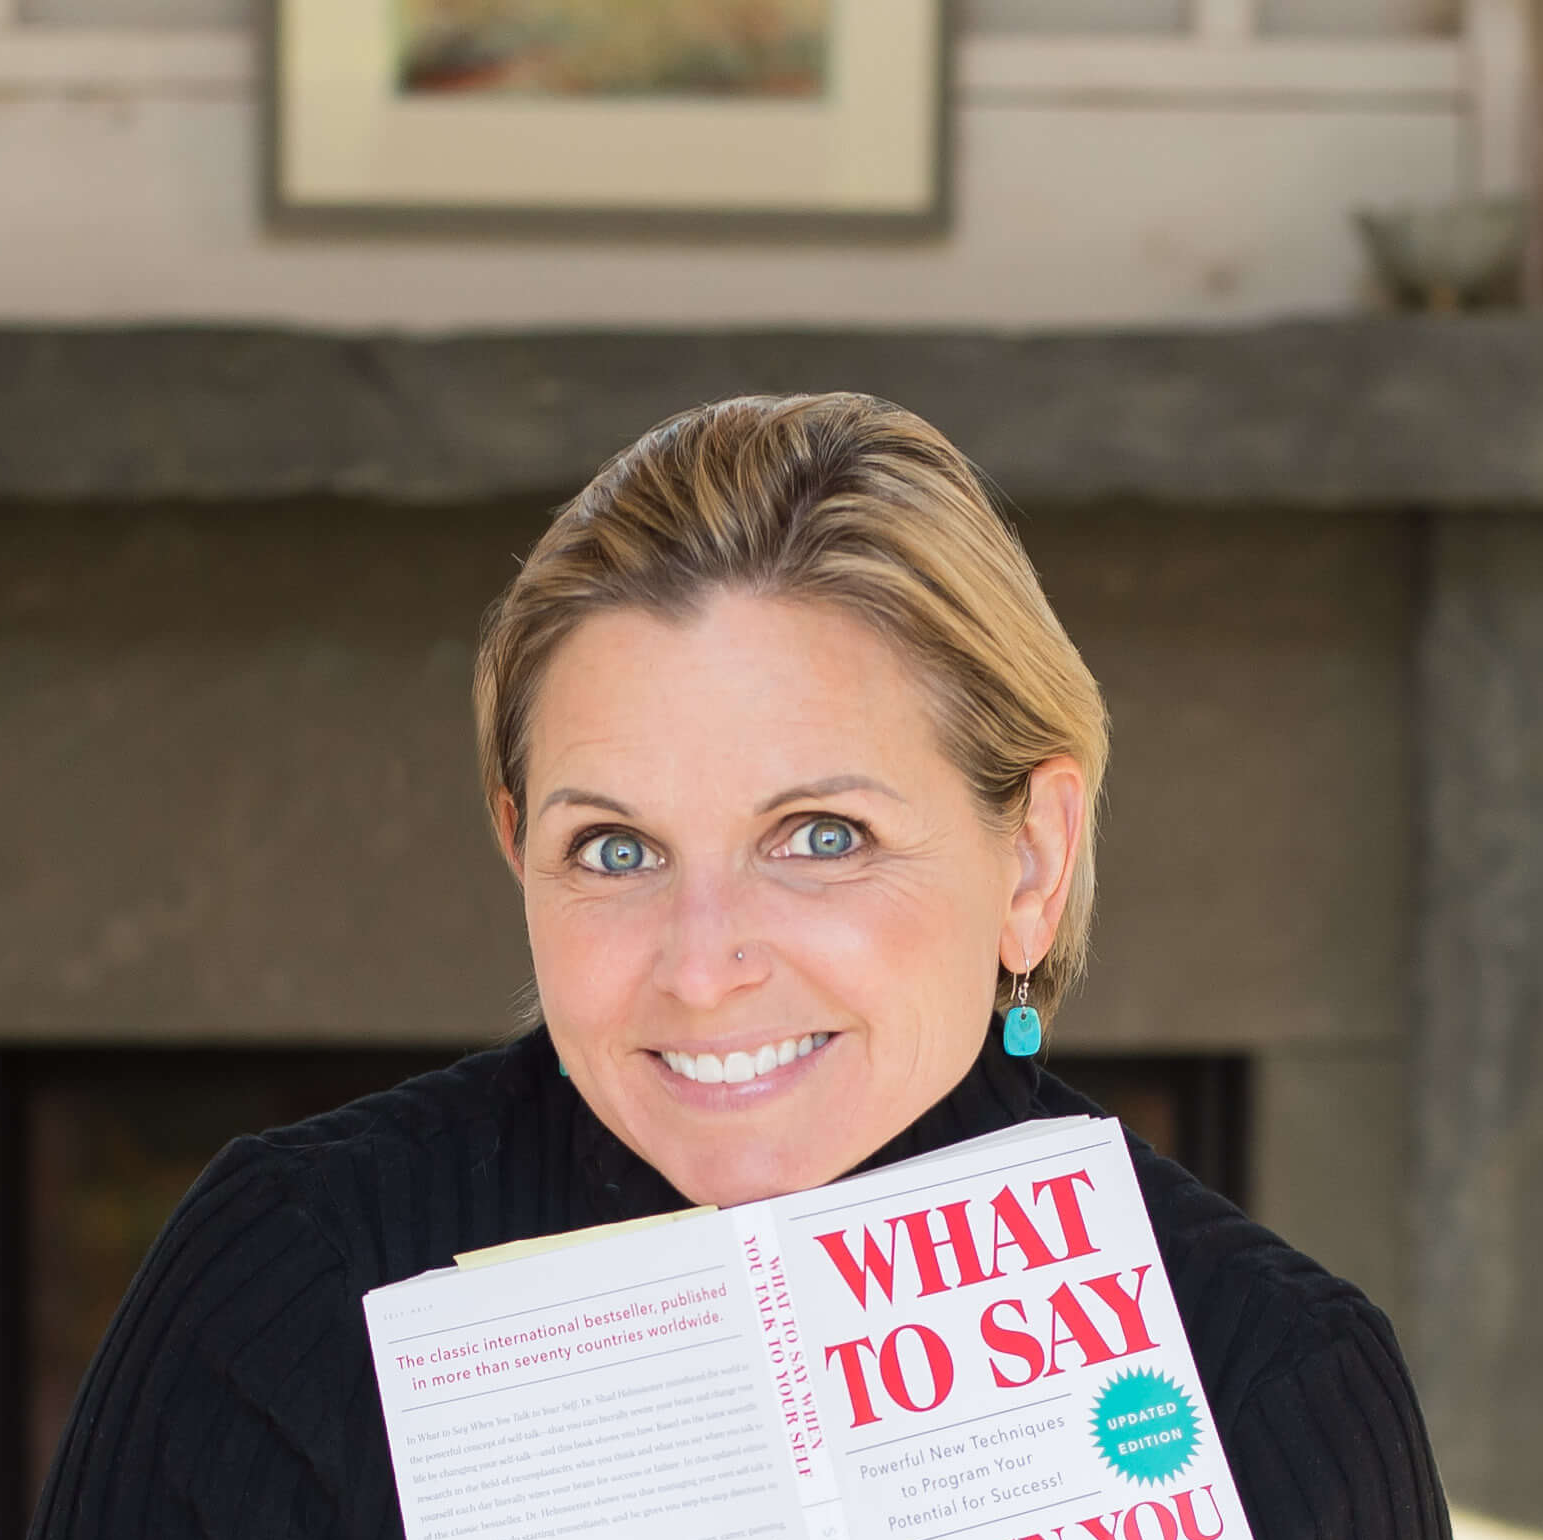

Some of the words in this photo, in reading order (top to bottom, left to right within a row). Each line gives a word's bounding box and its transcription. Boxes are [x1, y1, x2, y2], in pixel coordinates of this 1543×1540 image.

[743, 1234, 762, 1271] YOU
[812, 1167, 1101, 1312] WHAT
[754, 1282, 776, 1331] TALK
[769, 1255, 791, 1308] WHAT
[395, 1354, 424, 1369] The
[430, 1341, 479, 1362] classic
[483, 1316, 579, 1351] international
[583, 1302, 657, 1328] bestseller,
[660, 1282, 726, 1313] published
[411, 1377, 426, 1390] in
[431, 1369, 470, 1386] more
[475, 1360, 509, 1376] than
[514, 1346, 570, 1368] seventy
[576, 1330, 643, 1353] countries
[646, 1310, 722, 1336] worldwide.
[767, 1337, 784, 1363] TO
[781, 1318, 798, 1343] TO
[823, 1323, 954, 1429] TO
[979, 1263, 1161, 1388] SAY
[788, 1351, 807, 1383] SAY
[775, 1369, 798, 1425] YOUR
[801, 1391, 822, 1449] WHEN
[1107, 1403, 1175, 1428] UPDATED
[789, 1431, 811, 1475] SELF
[859, 1448, 925, 1479] Powerful
[929, 1442, 964, 1461] New
[969, 1416, 1064, 1449] Techniques
[1118, 1429, 1181, 1454] EDITION
[888, 1498, 957, 1530] Potential
[961, 1495, 985, 1511] for
[990, 1471, 1063, 1502] Success!
[900, 1485, 917, 1497] to
[921, 1466, 990, 1492] Program
[993, 1454, 1032, 1472] Your
